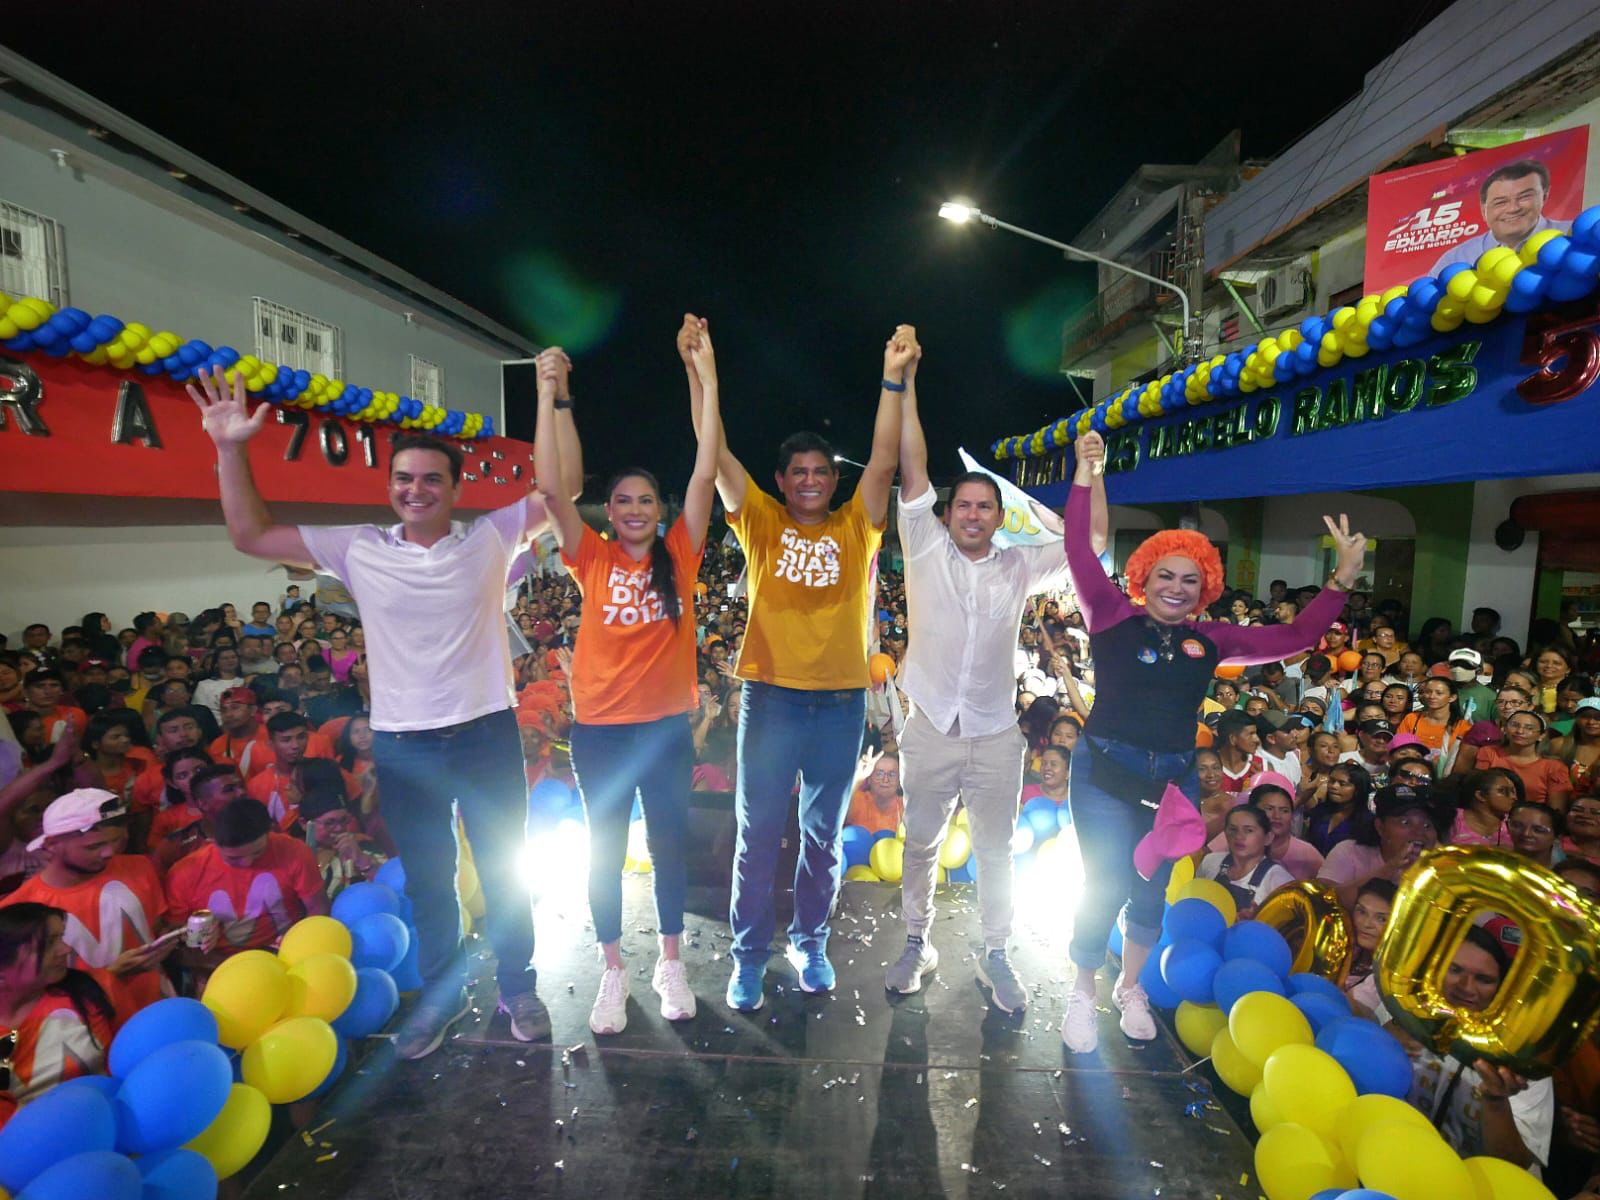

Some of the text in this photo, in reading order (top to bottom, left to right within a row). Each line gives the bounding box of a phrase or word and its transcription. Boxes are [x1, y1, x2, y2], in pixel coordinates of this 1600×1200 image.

[1410, 201, 1463, 231] 15
[1384, 224, 1479, 252] EDUARDO
[1396, 221, 1466, 239] GOVERNADOR
[1402, 244, 1425, 254] ANNE
[1427, 238, 1458, 248] MOURA
[1148, 397, 1281, 459] MARCELO
[1292, 340, 1482, 436] RAMOS
[781, 532, 841, 557] MAYRA
[774, 558, 840, 587] 70125
[782, 549, 840, 573] DIAS
